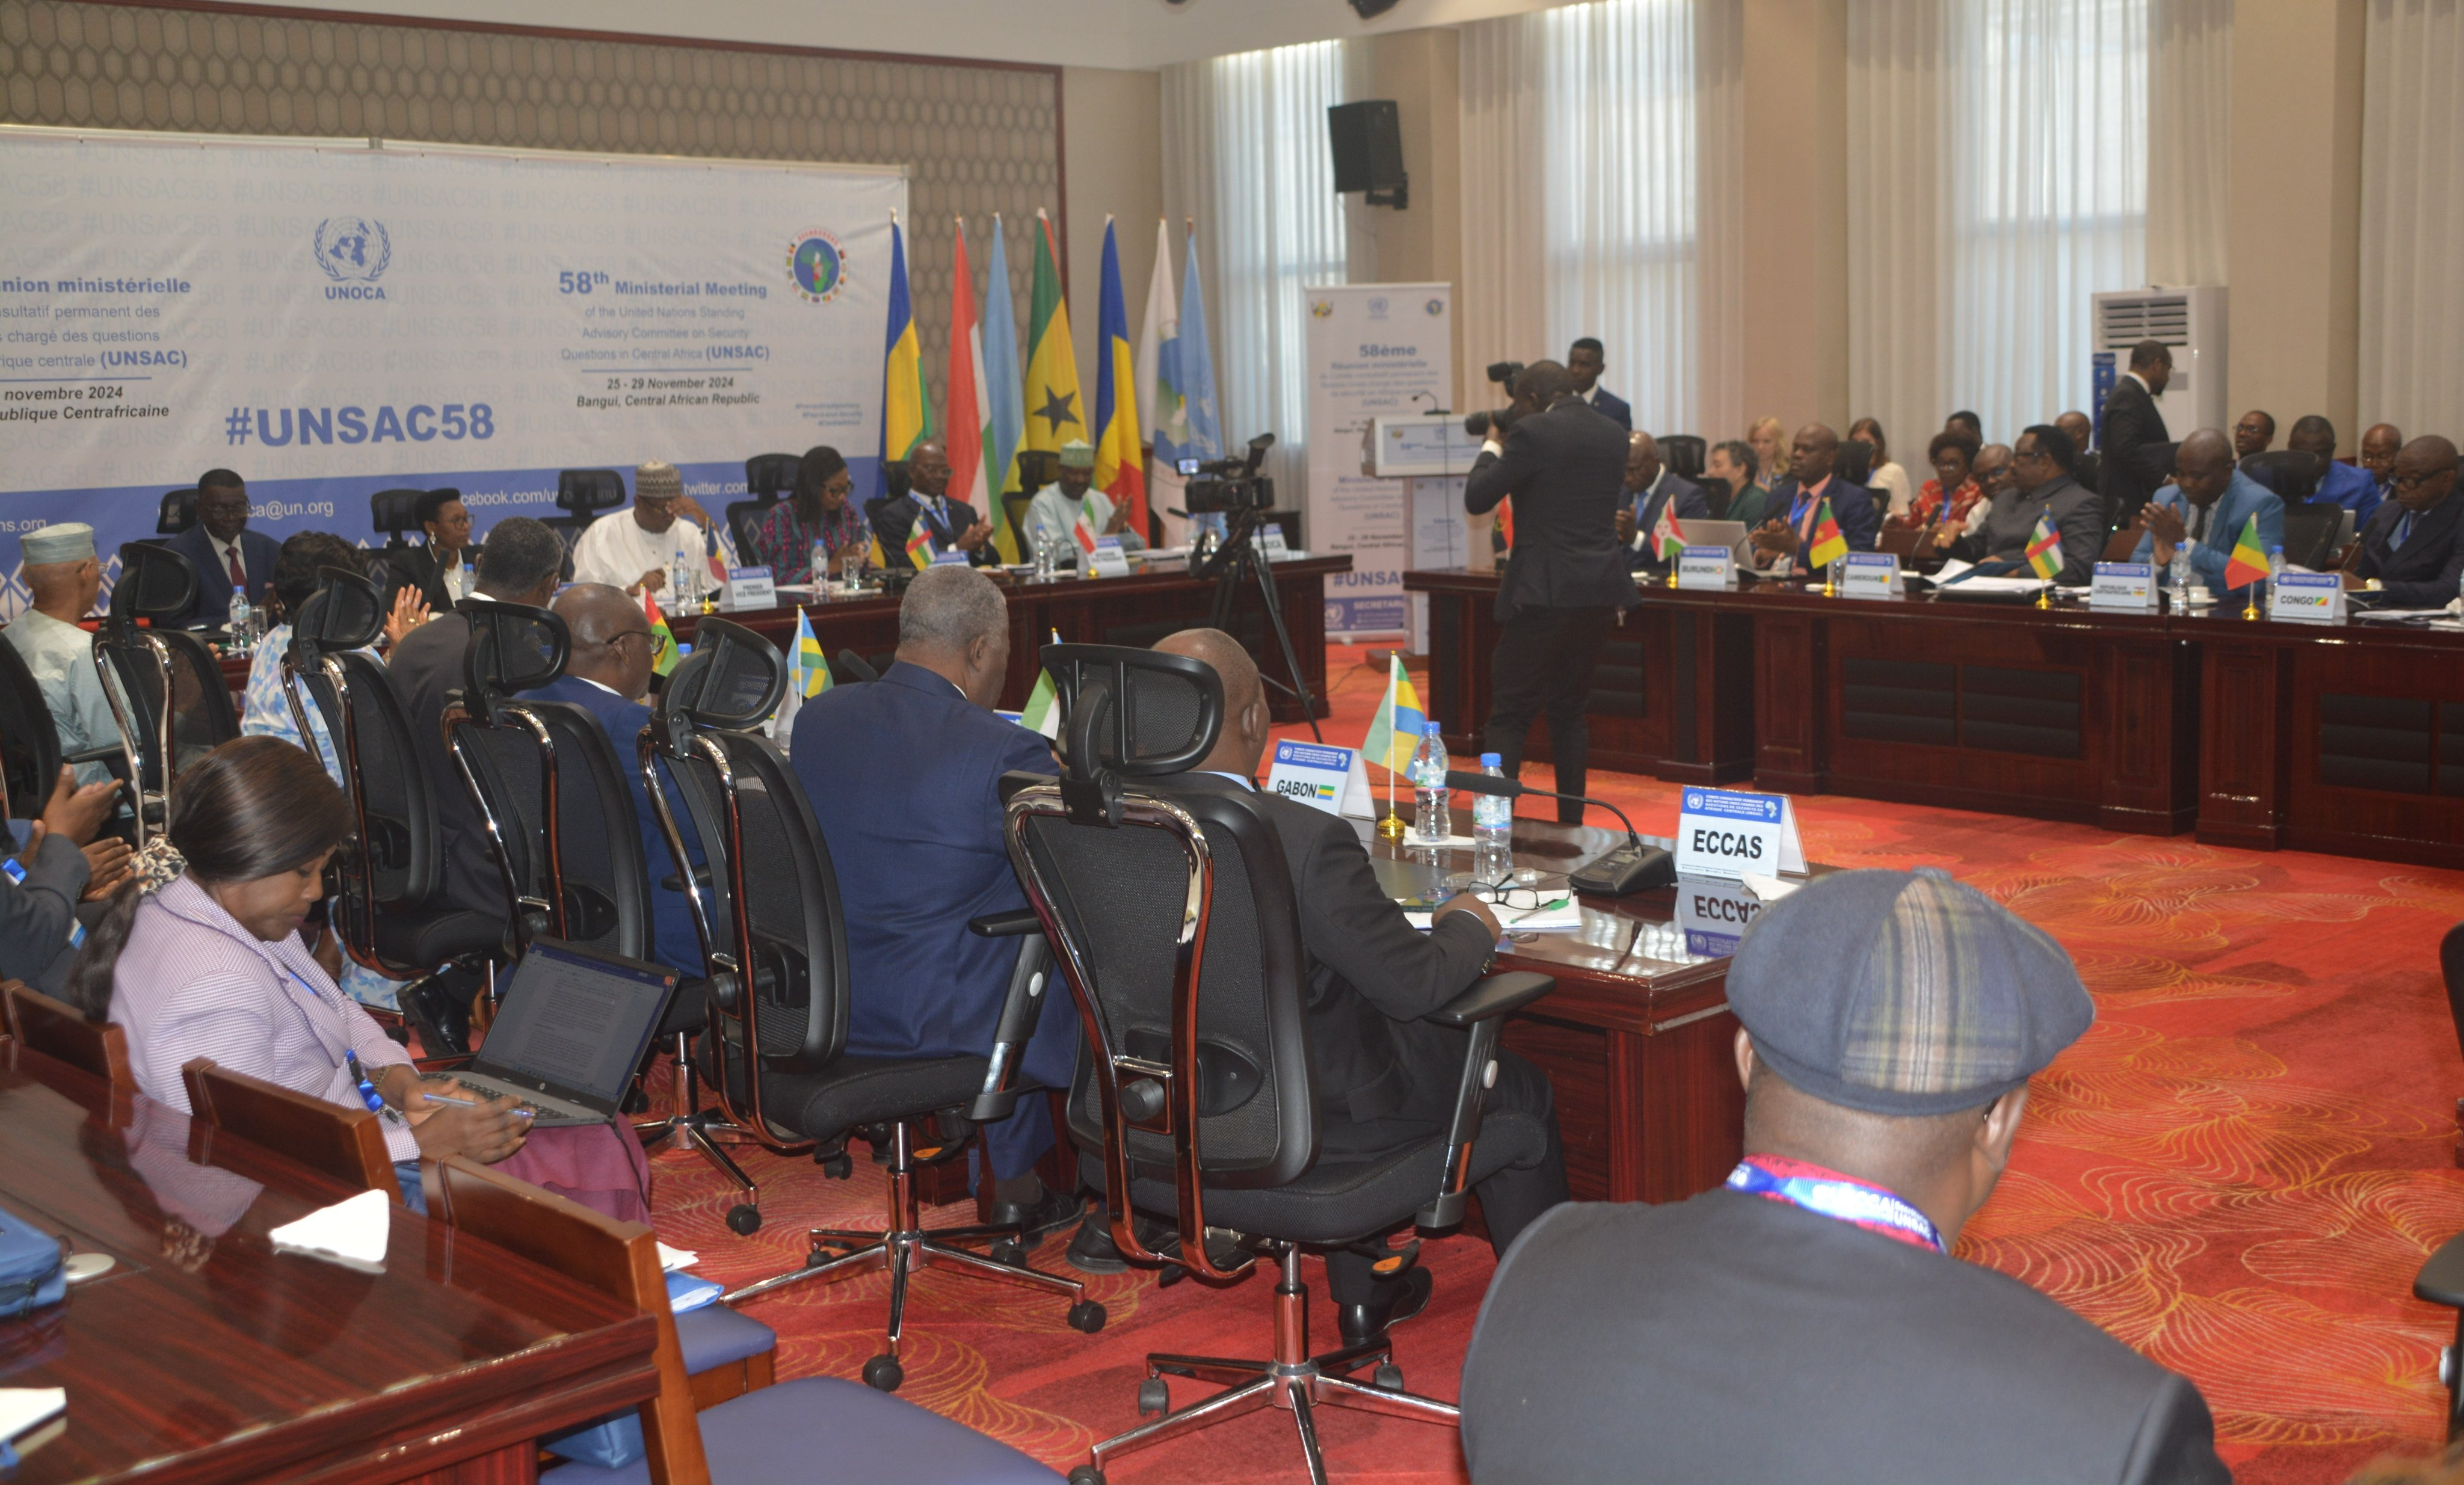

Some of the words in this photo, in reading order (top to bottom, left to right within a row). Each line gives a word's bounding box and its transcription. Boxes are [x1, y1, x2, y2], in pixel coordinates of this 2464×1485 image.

[0, 277, 50, 293] nion
[58, 277, 191, 293] ministérielle
[324, 286, 386, 300] UNOCA
[559, 271, 609, 294] 58th
[615, 281, 700, 295] Ministerial
[706, 282, 767, 299] Meeting
[55, 305, 132, 321] permanent
[135, 305, 161, 318] des
[585, 305, 596, 318] of
[599, 306, 616, 318] the
[619, 306, 654, 318] United
[656, 306, 697, 318] Nations
[700, 306, 745, 321] Standing
[7, 329, 58, 345] chargé
[62, 330, 88, 342] des
[93, 330, 161, 343] questions
[582, 327, 629, 340] Advisory
[632, 327, 689, 339] Committee
[692, 329, 706, 339] on
[707, 327, 750, 340] Security
[561, 347, 617, 361] Questions
[620, 347, 629, 360] in
[632, 347, 671, 360] Central
[673, 346, 703, 359] Africa
[706, 345, 770, 362] (UNSAC)
[1359, 343, 1417, 357] 58ème
[38, 354, 96, 367] centrale
[100, 349, 188, 370] (UNSAC)
[607, 378, 621, 390] 25
[632, 378, 645, 390] 29
[647, 377, 705, 390] November
[709, 376, 735, 389] 2024
[4, 387, 84, 401] novembre
[88, 386, 123, 399] 2024
[576, 395, 621, 410] Bangui,
[624, 394, 667, 407] Central
[668, 393, 710, 406] African
[712, 392, 760, 407] Republic
[63, 404, 170, 420] Centrafricaine
[224, 402, 495, 447] #UNSAC58
[246, 500, 334, 521] ca@un.org
[1681, 565, 1713, 573] BURUNDI
[2280, 595, 2314, 606] CONGO
[1277, 779, 1317, 798] GABON
[1692, 829, 1763, 859] ECCAS
